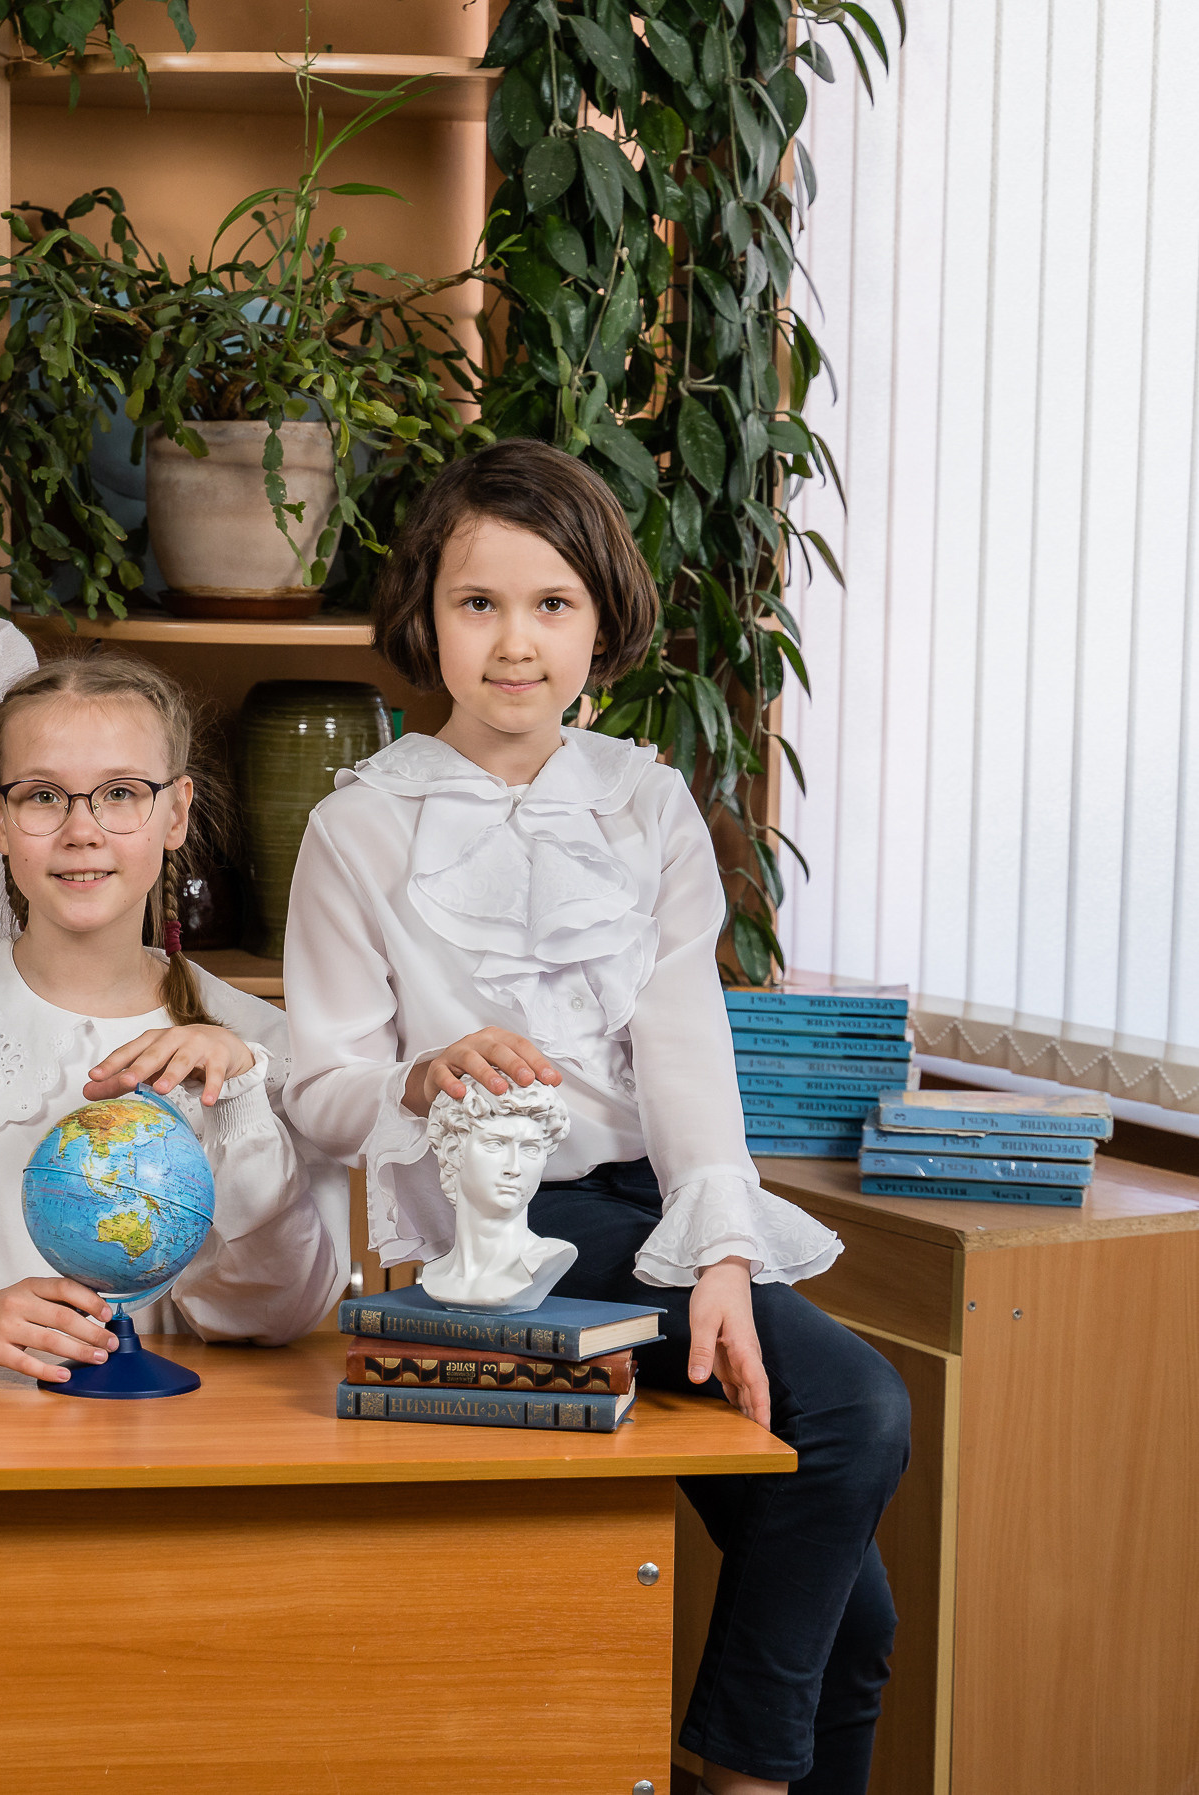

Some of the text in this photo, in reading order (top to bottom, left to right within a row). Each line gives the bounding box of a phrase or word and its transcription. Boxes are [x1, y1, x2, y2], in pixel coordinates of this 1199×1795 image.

[386, 1315, 463, 1338] ПУШКИН
[446, 1362, 476, 1372] КУПЕР
[389, 1397, 480, 1417] ПУШКИН
